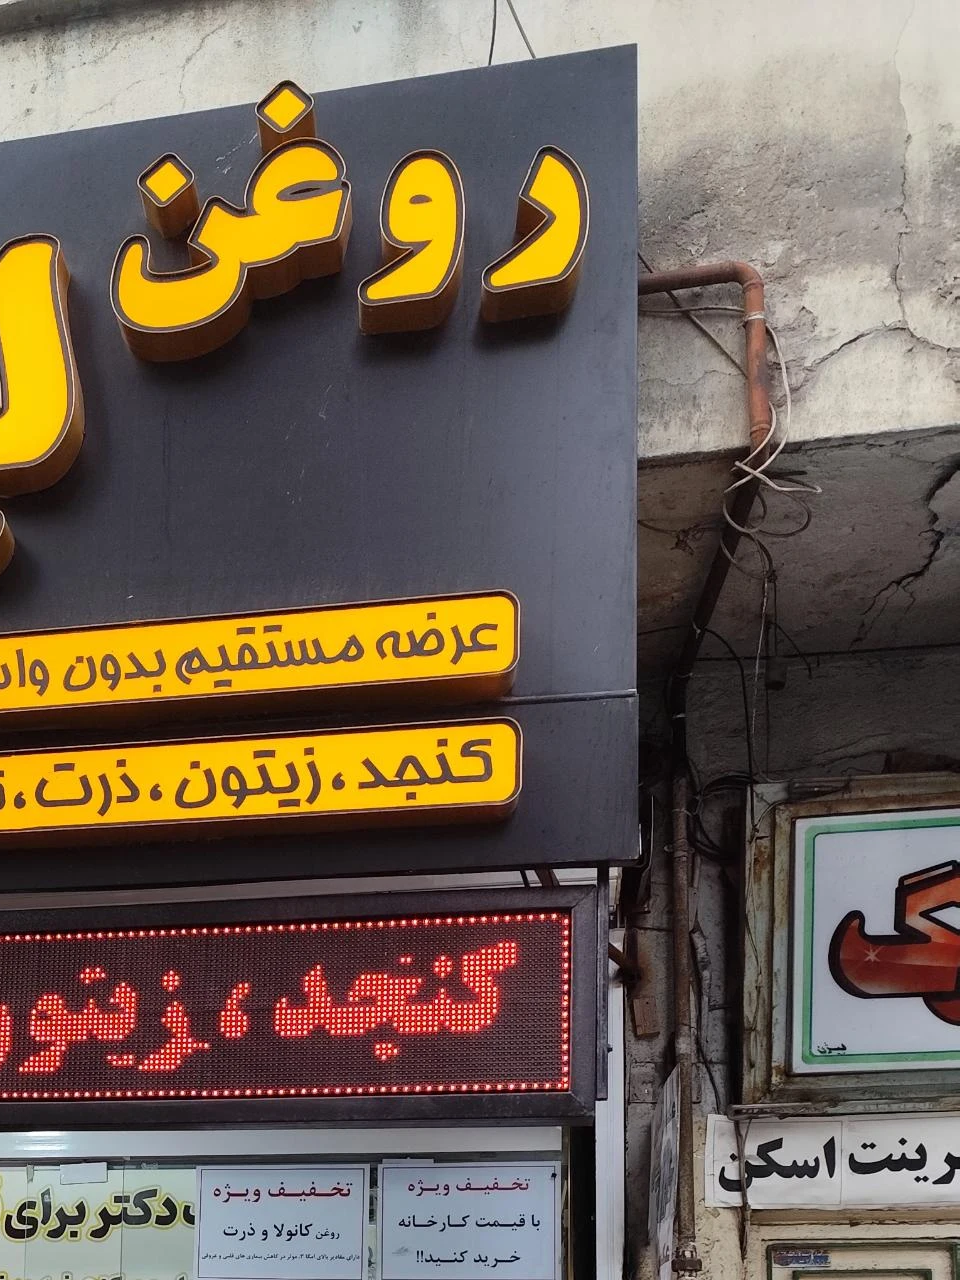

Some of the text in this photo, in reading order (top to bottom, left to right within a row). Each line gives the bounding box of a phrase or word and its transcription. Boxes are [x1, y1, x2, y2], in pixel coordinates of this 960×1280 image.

[110, 80, 590, 340] روغن
[174, 624, 365, 688] مستقیم
[374, 612, 499, 666] عرضه
[62, 648, 167, 694] بدون
[407, 1177, 531, 1197] تخفیف ویژه
[718, 1135, 837, 1193] اسکن
[3, 1187, 87, 1240] برای
[89, 1188, 178, 1239] دکتر
[213, 1181, 353, 1203] تخفیف ویژه
[223, 1222, 340, 1242] روغن کانولا و ذرت
[398, 1213, 541, 1232] با قیمت کارخانه
[473, 1250, 521, 1268] خرید
